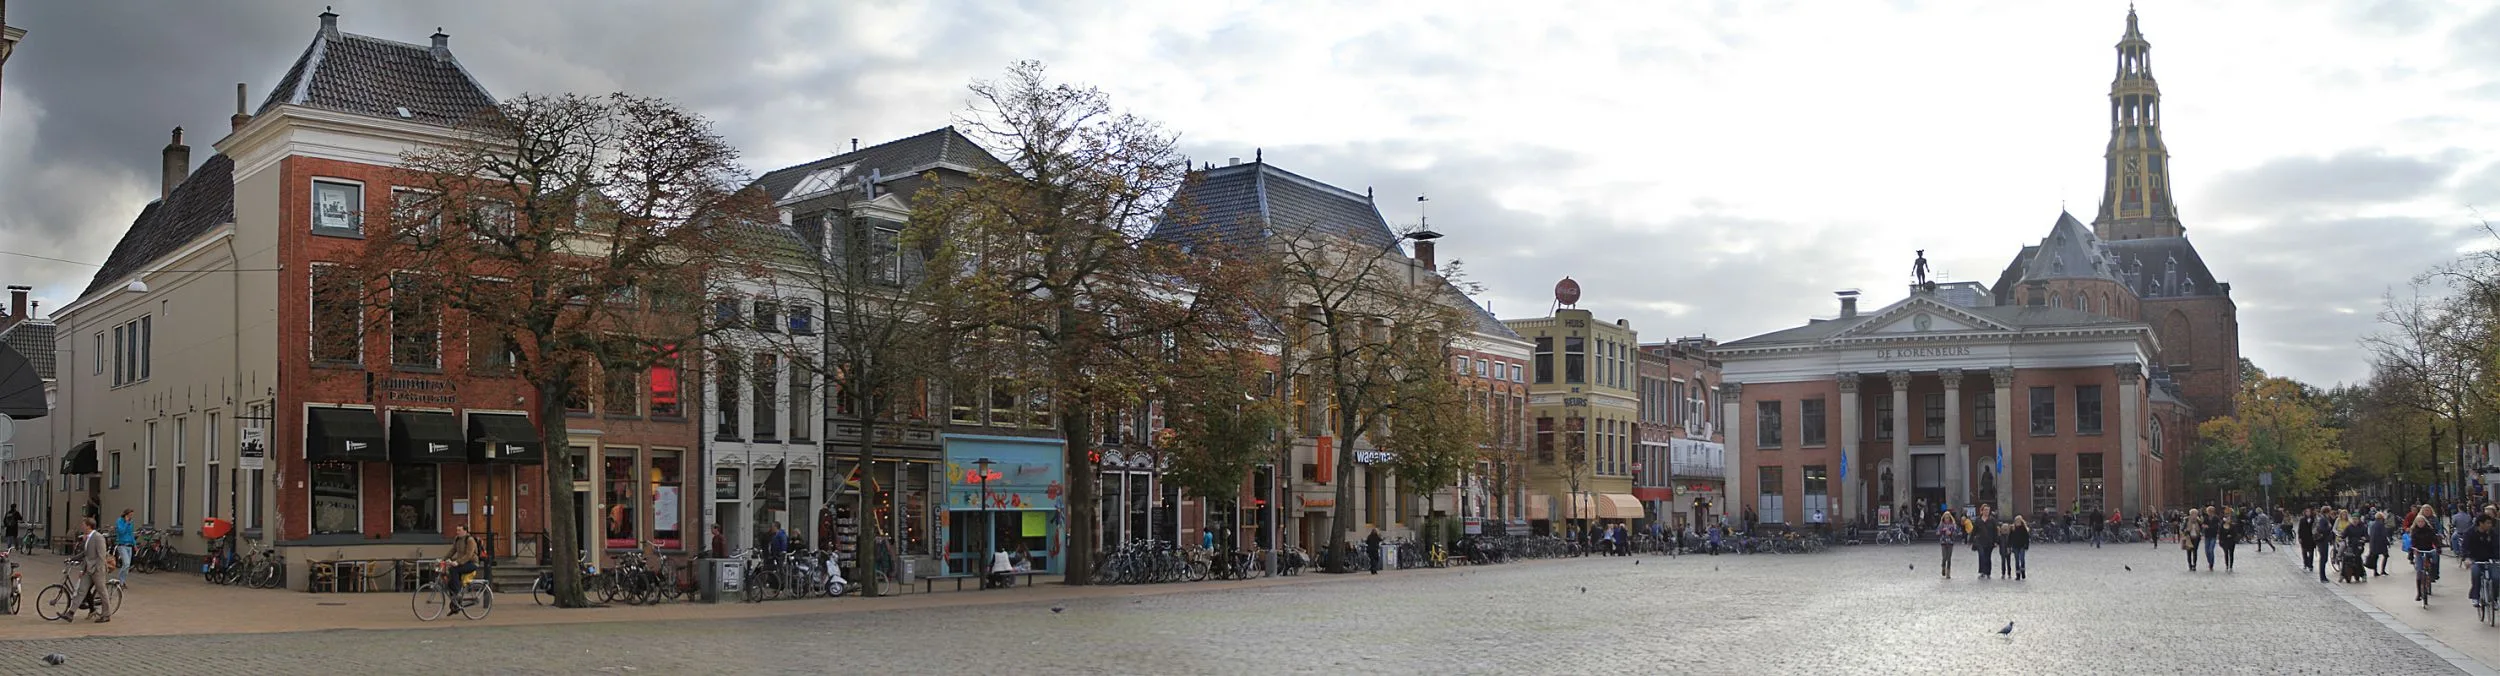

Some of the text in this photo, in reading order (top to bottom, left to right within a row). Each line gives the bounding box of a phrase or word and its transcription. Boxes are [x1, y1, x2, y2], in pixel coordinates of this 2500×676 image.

[1564, 319, 1585, 328] HUIS
[1876, 346, 1971, 359] DE KORENBEURS
[1563, 397, 1588, 408] BEURS
